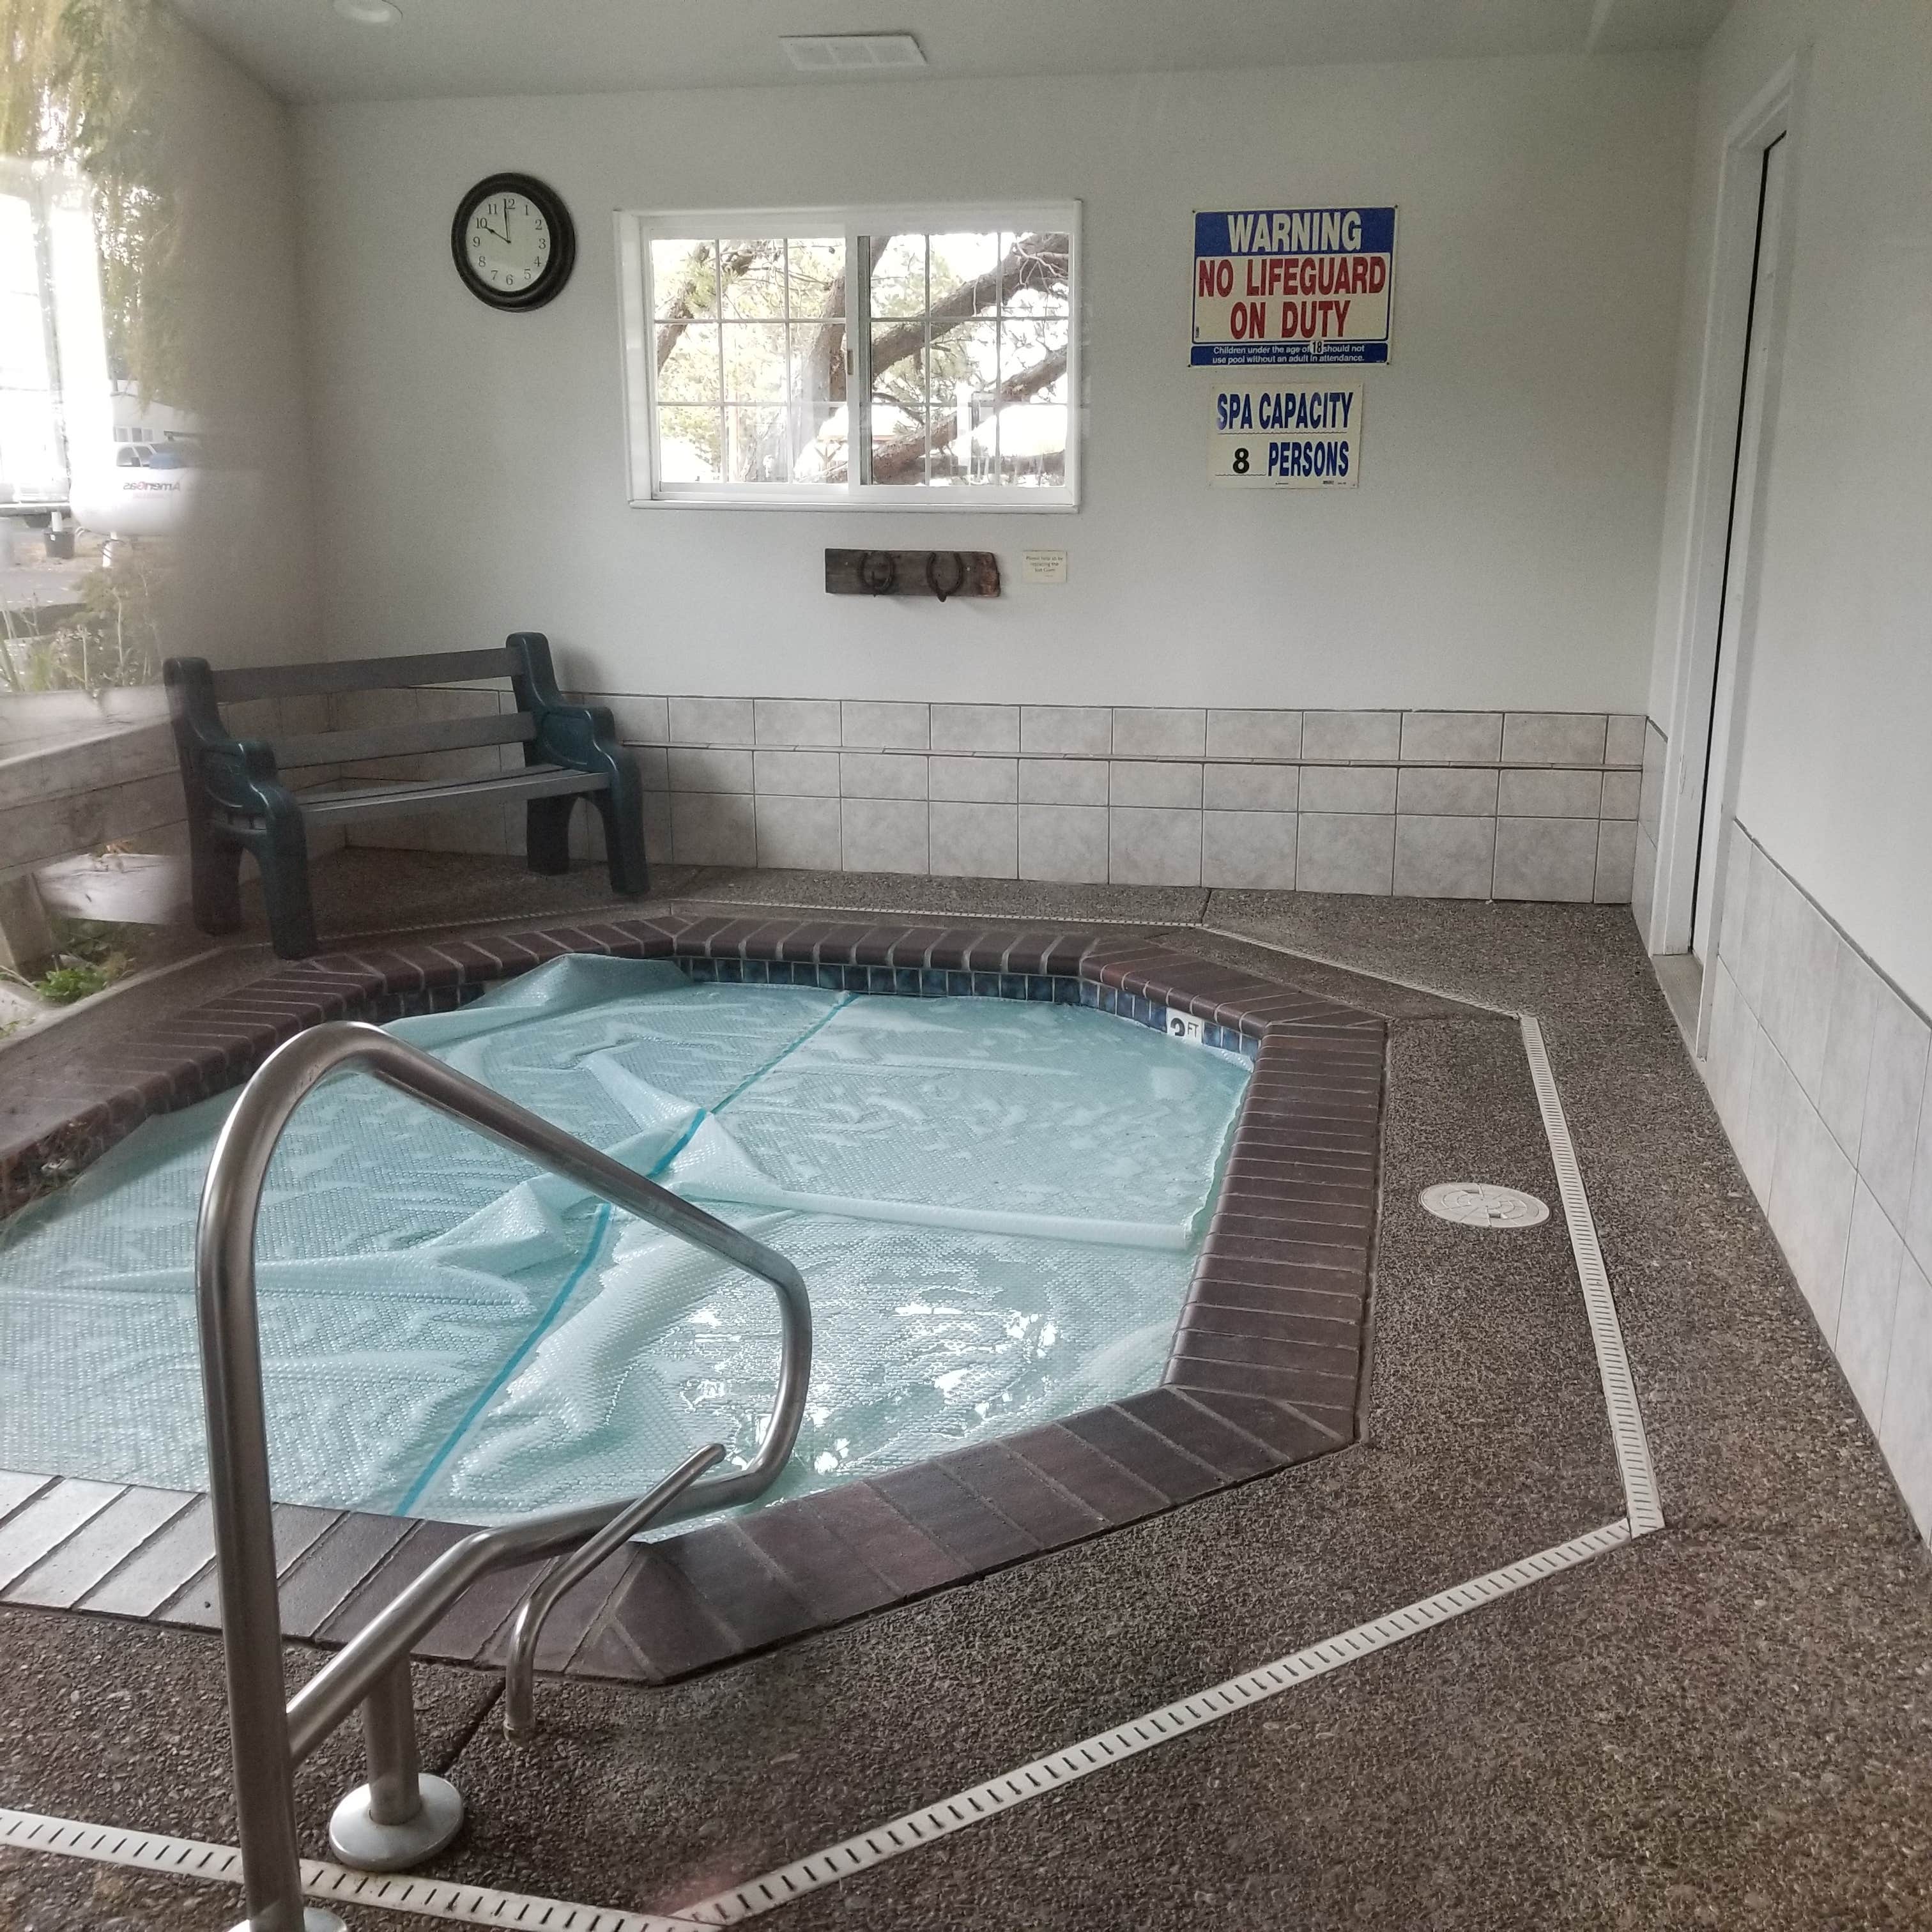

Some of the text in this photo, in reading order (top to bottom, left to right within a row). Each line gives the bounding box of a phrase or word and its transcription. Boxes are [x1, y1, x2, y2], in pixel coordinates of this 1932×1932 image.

[487, 204, 498, 215] 11
[525, 204, 530, 215] 1
[476, 217, 487, 229] 10
[535, 219, 542, 230] 2
[1227, 210, 1362, 253] WARNING
[473, 236, 480, 247] 9
[539, 238, 546, 249] 3
[479, 256, 486, 266] 8
[533, 256, 542, 267] 4
[491, 270, 498, 280] 7
[506, 274, 514, 285] 6
[524, 269, 531, 280] 5
[1199, 256, 1386, 297] NO LIFEGUARD
[1230, 300, 1351, 339] ON DUTY
[1213, 346, 1246, 355] Children
[1312, 341, 1322, 353] 18
[1228, 356, 1245, 365] pool
[1216, 392, 1354, 430] SPA CAPACITY
[1232, 441, 1349, 477] 8 PERSONS
[1187, 1022, 1199, 1038] FT
